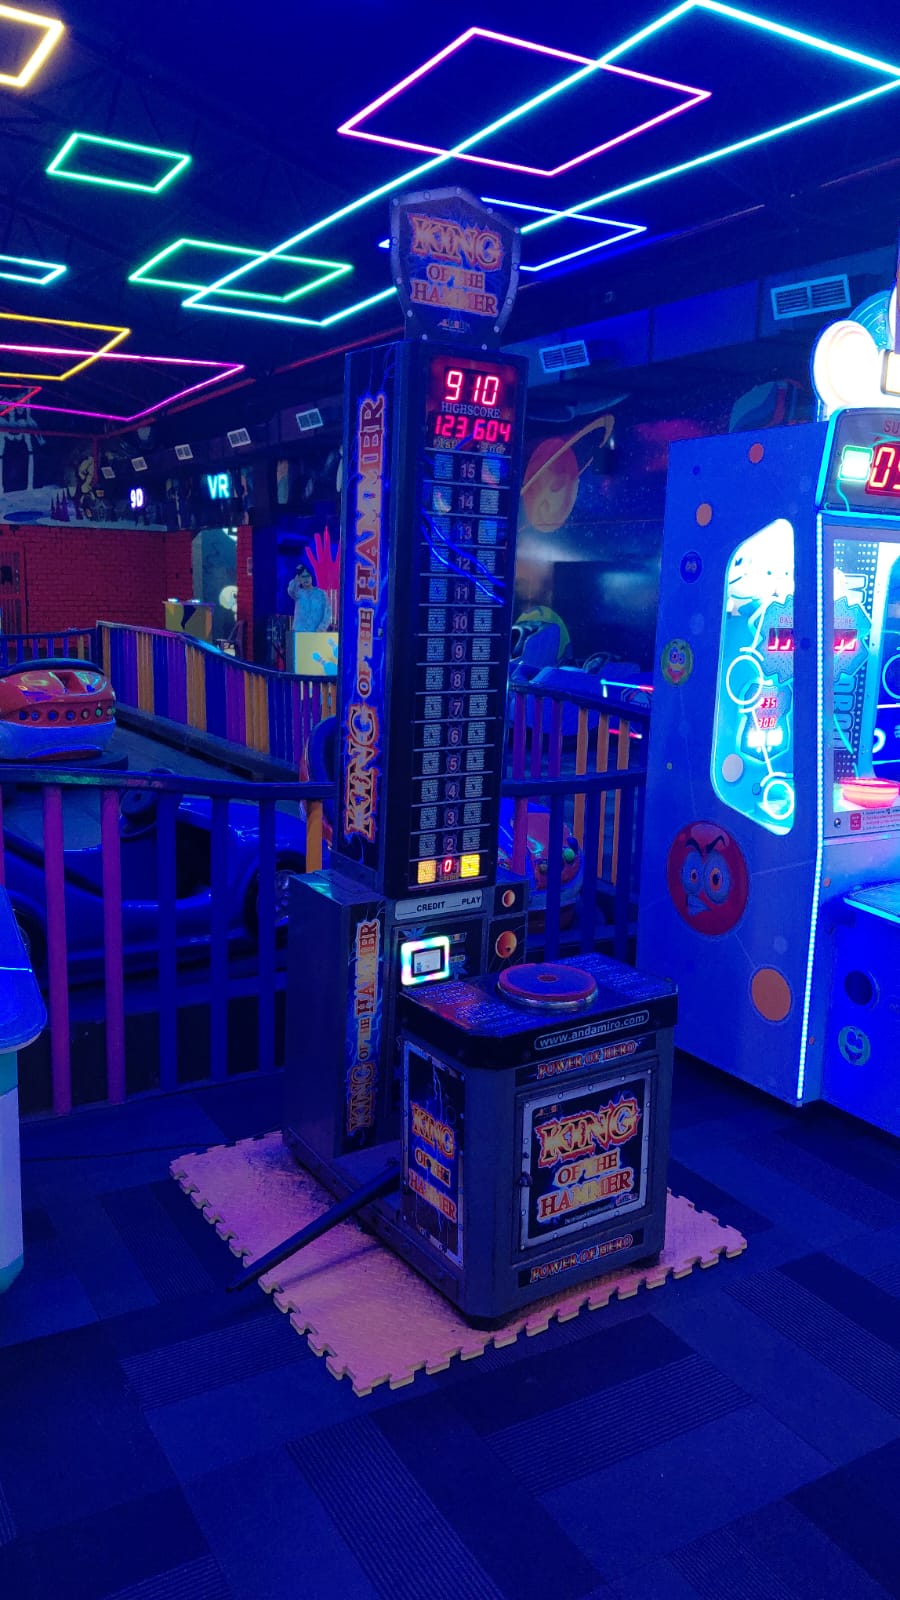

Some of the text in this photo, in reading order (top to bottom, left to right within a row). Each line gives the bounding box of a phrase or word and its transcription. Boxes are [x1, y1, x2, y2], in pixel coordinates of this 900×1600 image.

[411, 215, 501, 270] KING
[428, 264, 484, 290] OF THE
[411, 281, 498, 317] HAMMER
[445, 370, 499, 405] 910
[441, 402, 500, 418] HIGHSCORE
[435, 415, 511, 442] 123 604
[461, 464, 476, 478] 15
[869, 446, 900, 489] 0
[207, 473, 230, 500] VR
[356, 396, 384, 603] HAMMER
[460, 494, 474, 509] 14
[459, 525, 472, 540] 13
[457, 556, 471, 570] 12
[456, 586, 469, 600] 11
[454, 615, 468, 630] 10
[455, 644, 464, 659] 9
[453, 673, 462, 687] 8
[453, 702, 461, 716] 7
[451, 730, 460, 744] 6
[346, 704, 379, 842] KING
[450, 757, 457, 771] 5
[449, 784, 457, 798] 4
[447, 811, 455, 825] 3
[446, 838, 454, 851] 2
[416, 896, 481, 913] CREDIT PLAY
[355, 918, 380, 1017] HAMMER
[540, 1014, 645, 1048] www.andamiro.com
[537, 1040, 637, 1079] POWER OF HERO
[348, 1062, 376, 1135] KING
[411, 1102, 455, 1160] KING
[536, 1099, 640, 1167] KING
[556, 1148, 620, 1186] OF THE
[409, 1169, 457, 1223] HAMMER
[538, 1168, 634, 1221] HAMMER
[530, 1234, 633, 1282] POWER OF HERO
